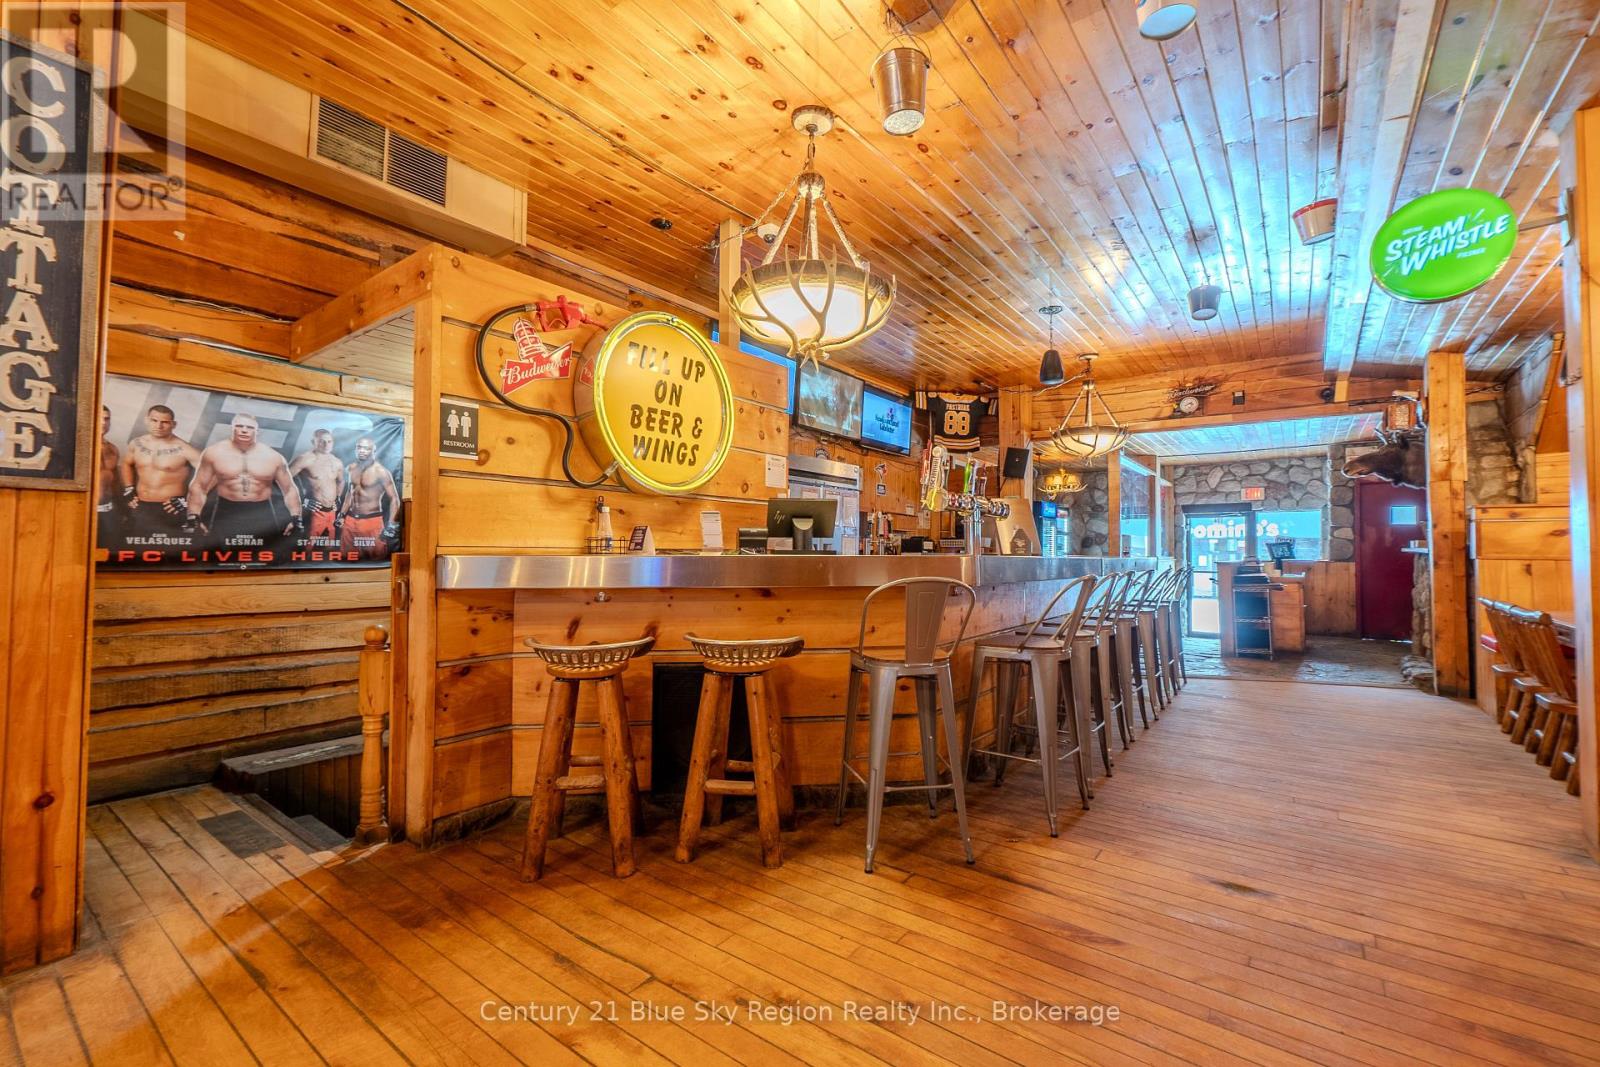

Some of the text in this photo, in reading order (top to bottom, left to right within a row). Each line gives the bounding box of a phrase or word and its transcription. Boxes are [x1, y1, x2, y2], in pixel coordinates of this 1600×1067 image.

[1385, 215, 1468, 262] STEAM
[1400, 214, 1510, 276] WHISTLE
[0, 56, 67, 471] COTTAGE
[500, 357, 571, 385] Budweiser
[625, 341, 671, 376] FILL
[681, 356, 706, 383] UP
[654, 379, 683, 407] ON
[630, 404, 703, 439] BEER &
[944, 410, 971, 436] 88
[443, 439, 475, 449] RESTROOM
[633, 434, 700, 466] WINGS
[125, 536, 193, 546] VELASQUEZ
[225, 538, 264, 547] LESNAR
[1191, 519, 1280, 539] omino's
[104, 549, 360, 562] FC LIVES HERE
